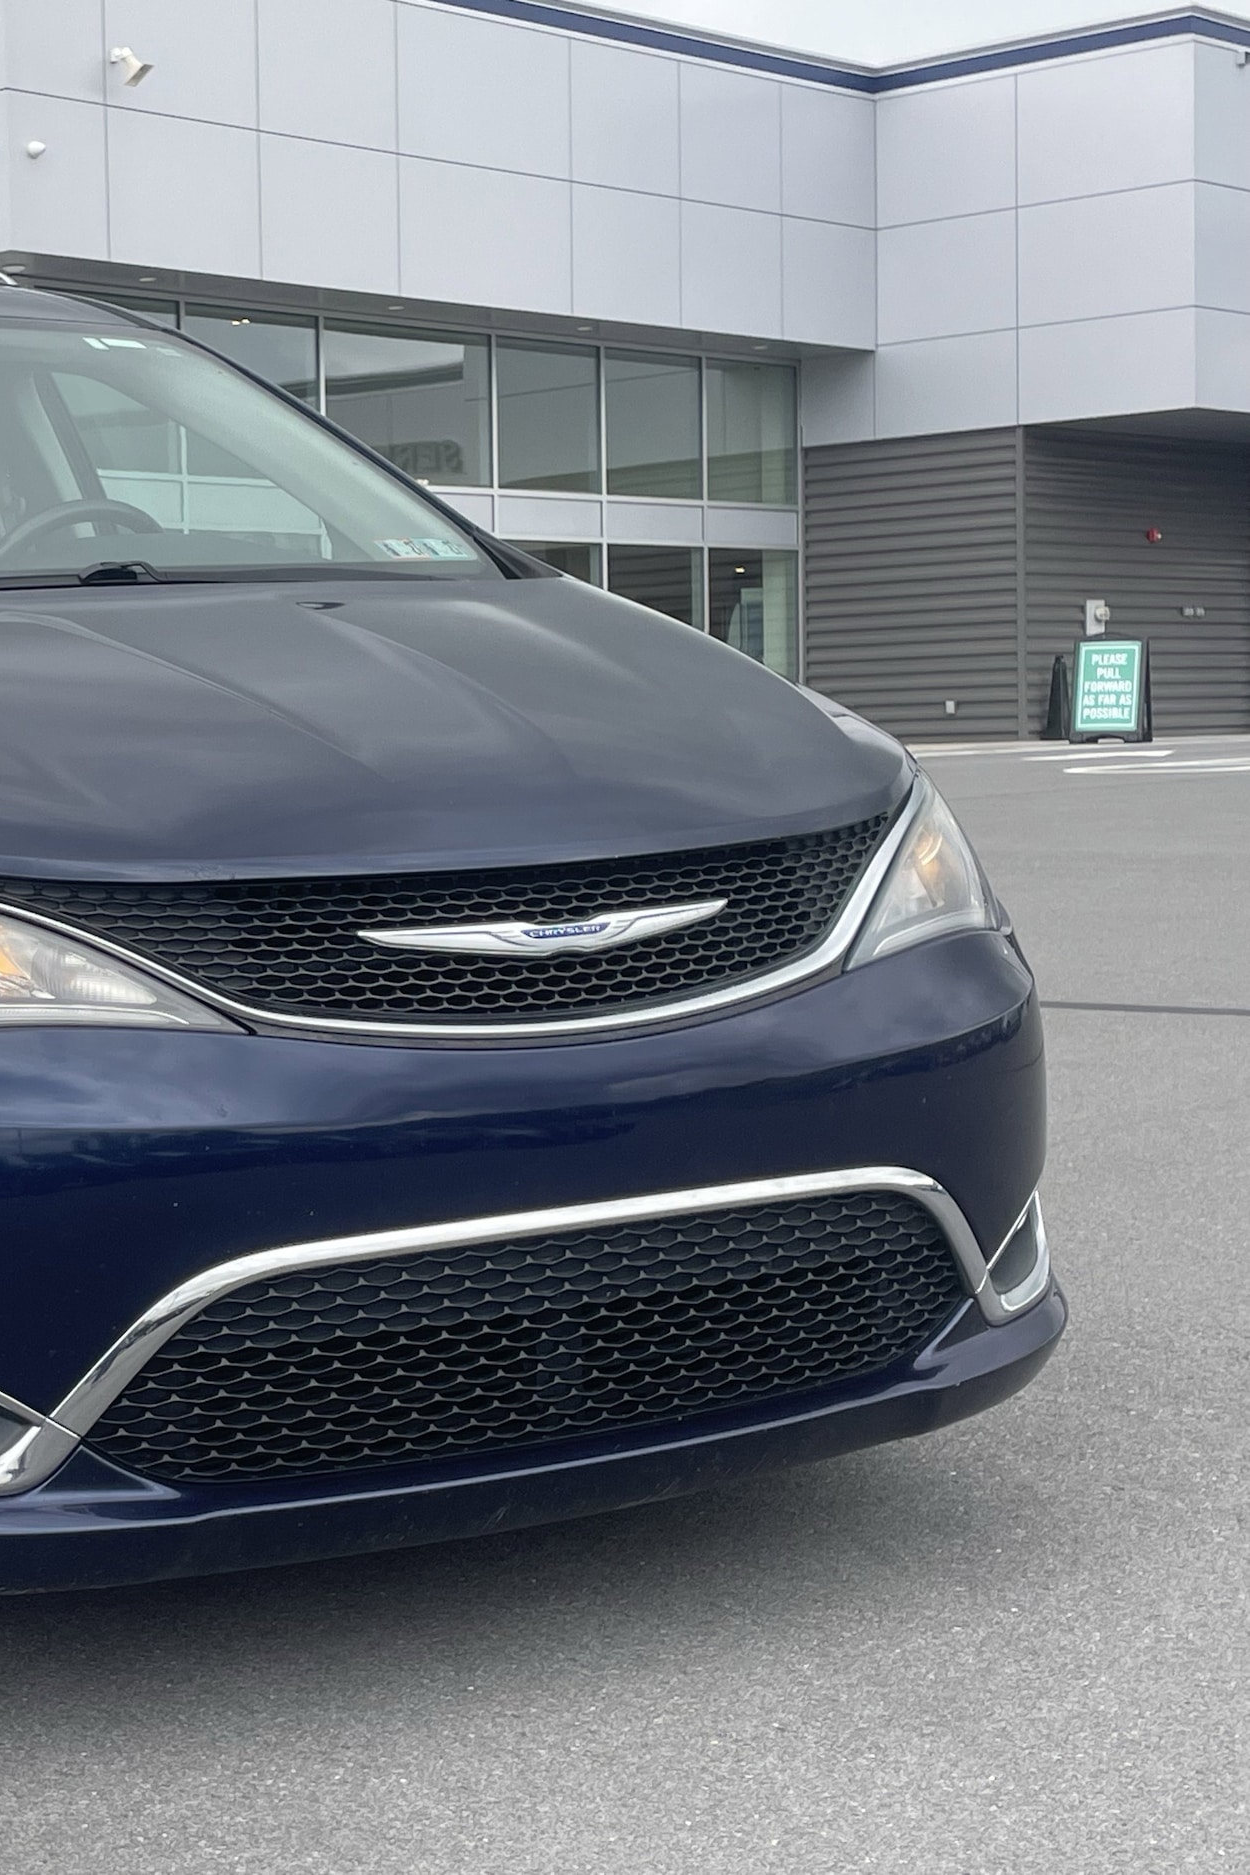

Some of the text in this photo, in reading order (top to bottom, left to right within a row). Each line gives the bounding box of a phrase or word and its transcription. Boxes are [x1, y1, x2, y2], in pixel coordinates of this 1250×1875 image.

[1091, 653, 1128, 666] PLEASE
[1096, 667, 1121, 679] PULL
[1084, 681, 1132, 693] FORWARD
[1082, 694, 1132, 706] AS FAR AS
[1082, 707, 1131, 720] POSSIBLE
[529, 924, 601, 938] CHRYSLER
